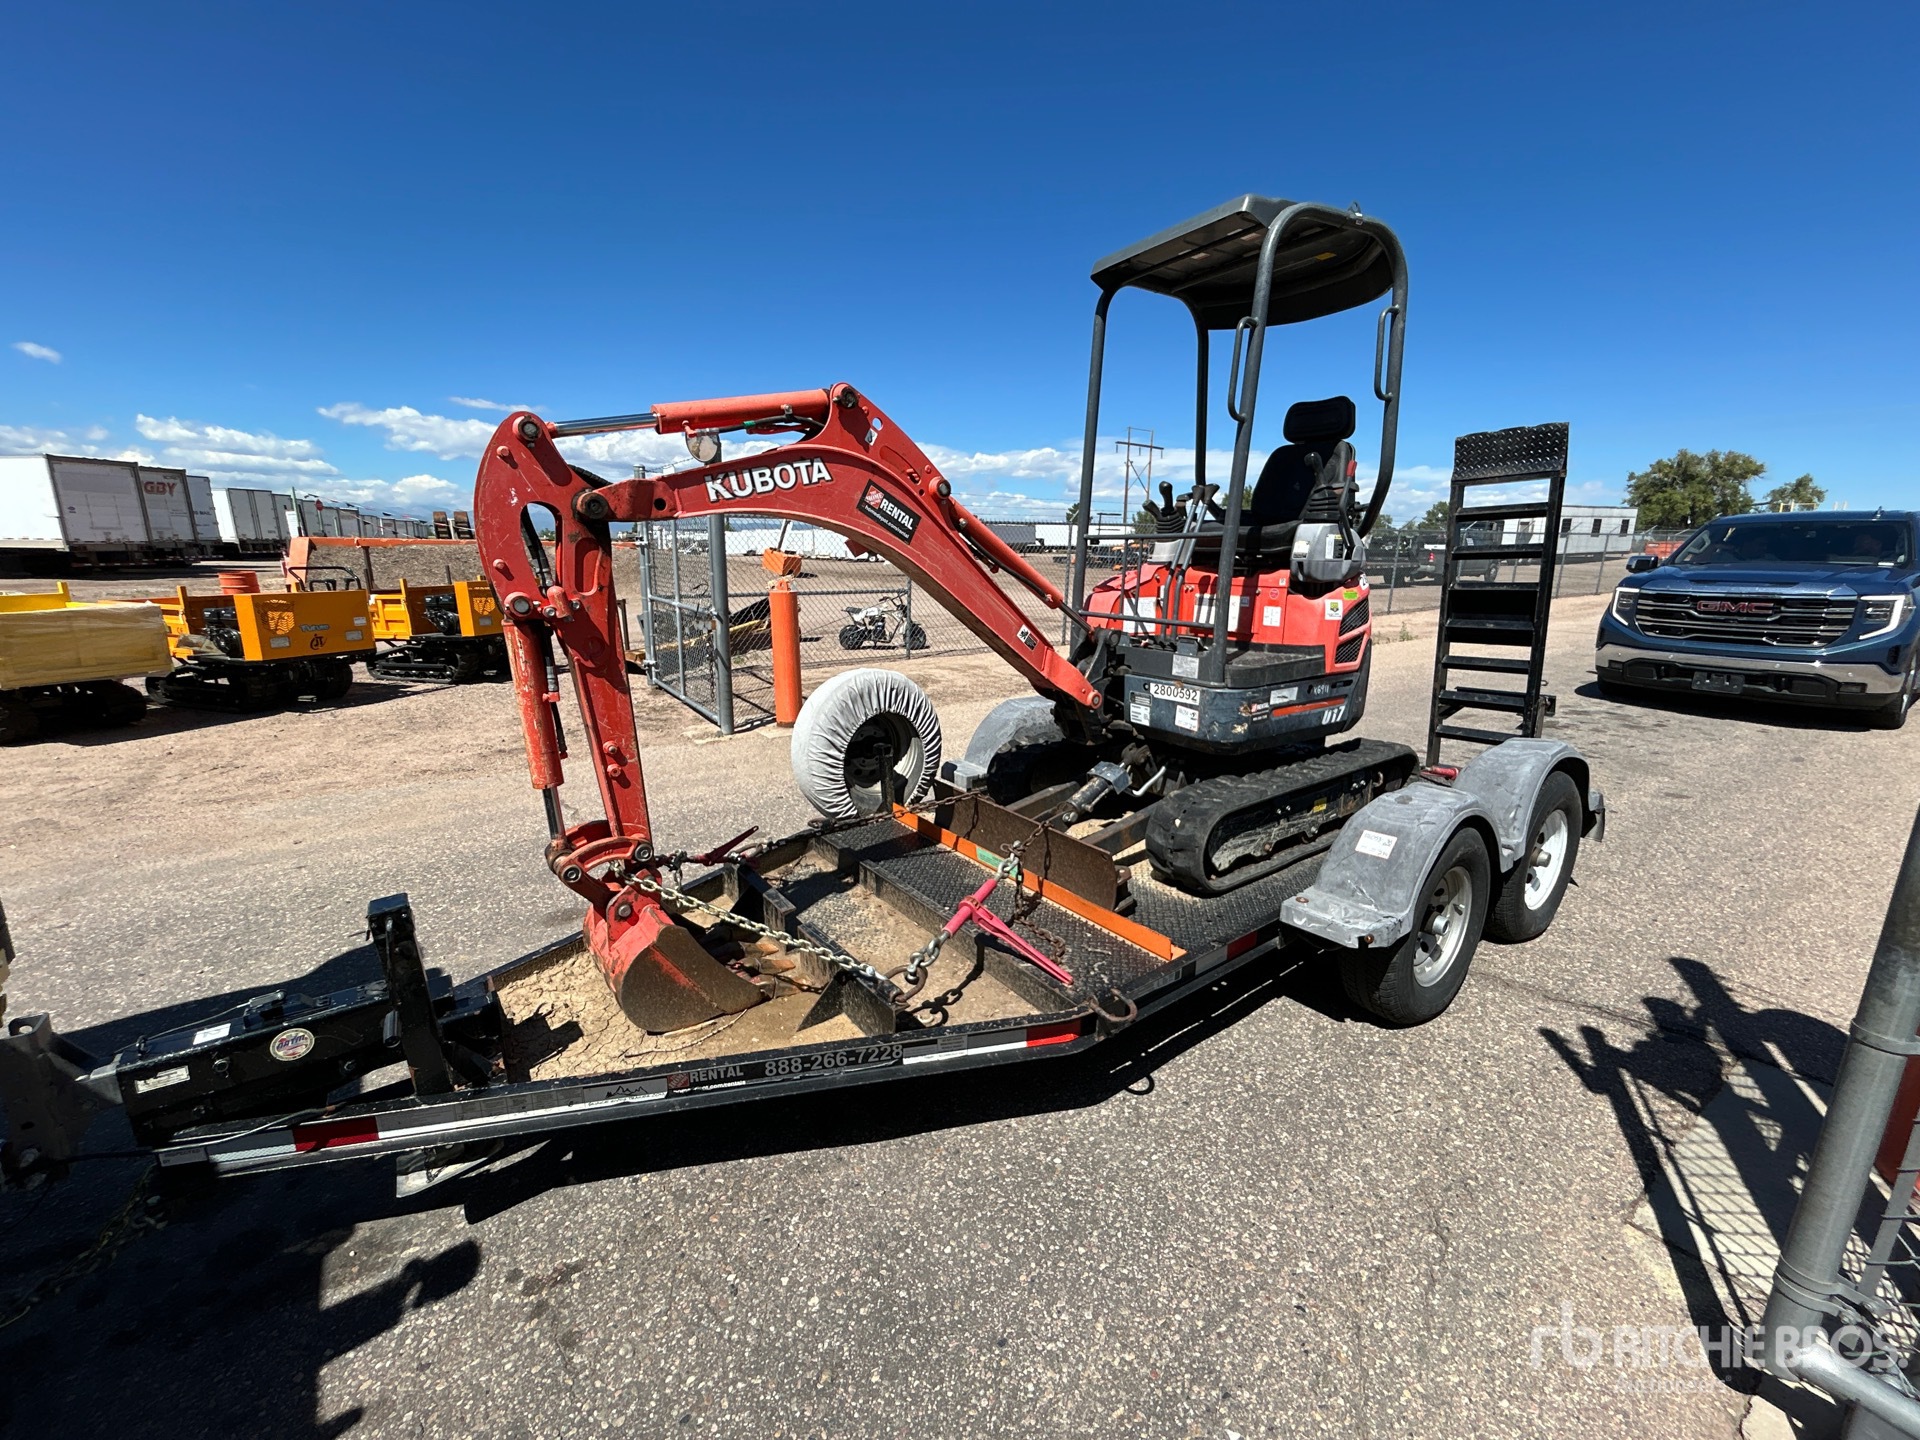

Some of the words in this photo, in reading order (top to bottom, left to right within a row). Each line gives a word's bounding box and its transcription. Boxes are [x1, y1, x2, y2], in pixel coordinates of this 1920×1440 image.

[704, 456, 832, 503] KUBOTA
[879, 497, 914, 531] RENTAL
[1696, 600, 1774, 615] GMC
[1153, 683, 1199, 703] 2800592
[1321, 705, 1347, 726] U17
[690, 1065, 745, 1084] RENTAL
[765, 1044, 903, 1077] 888-266-7228
